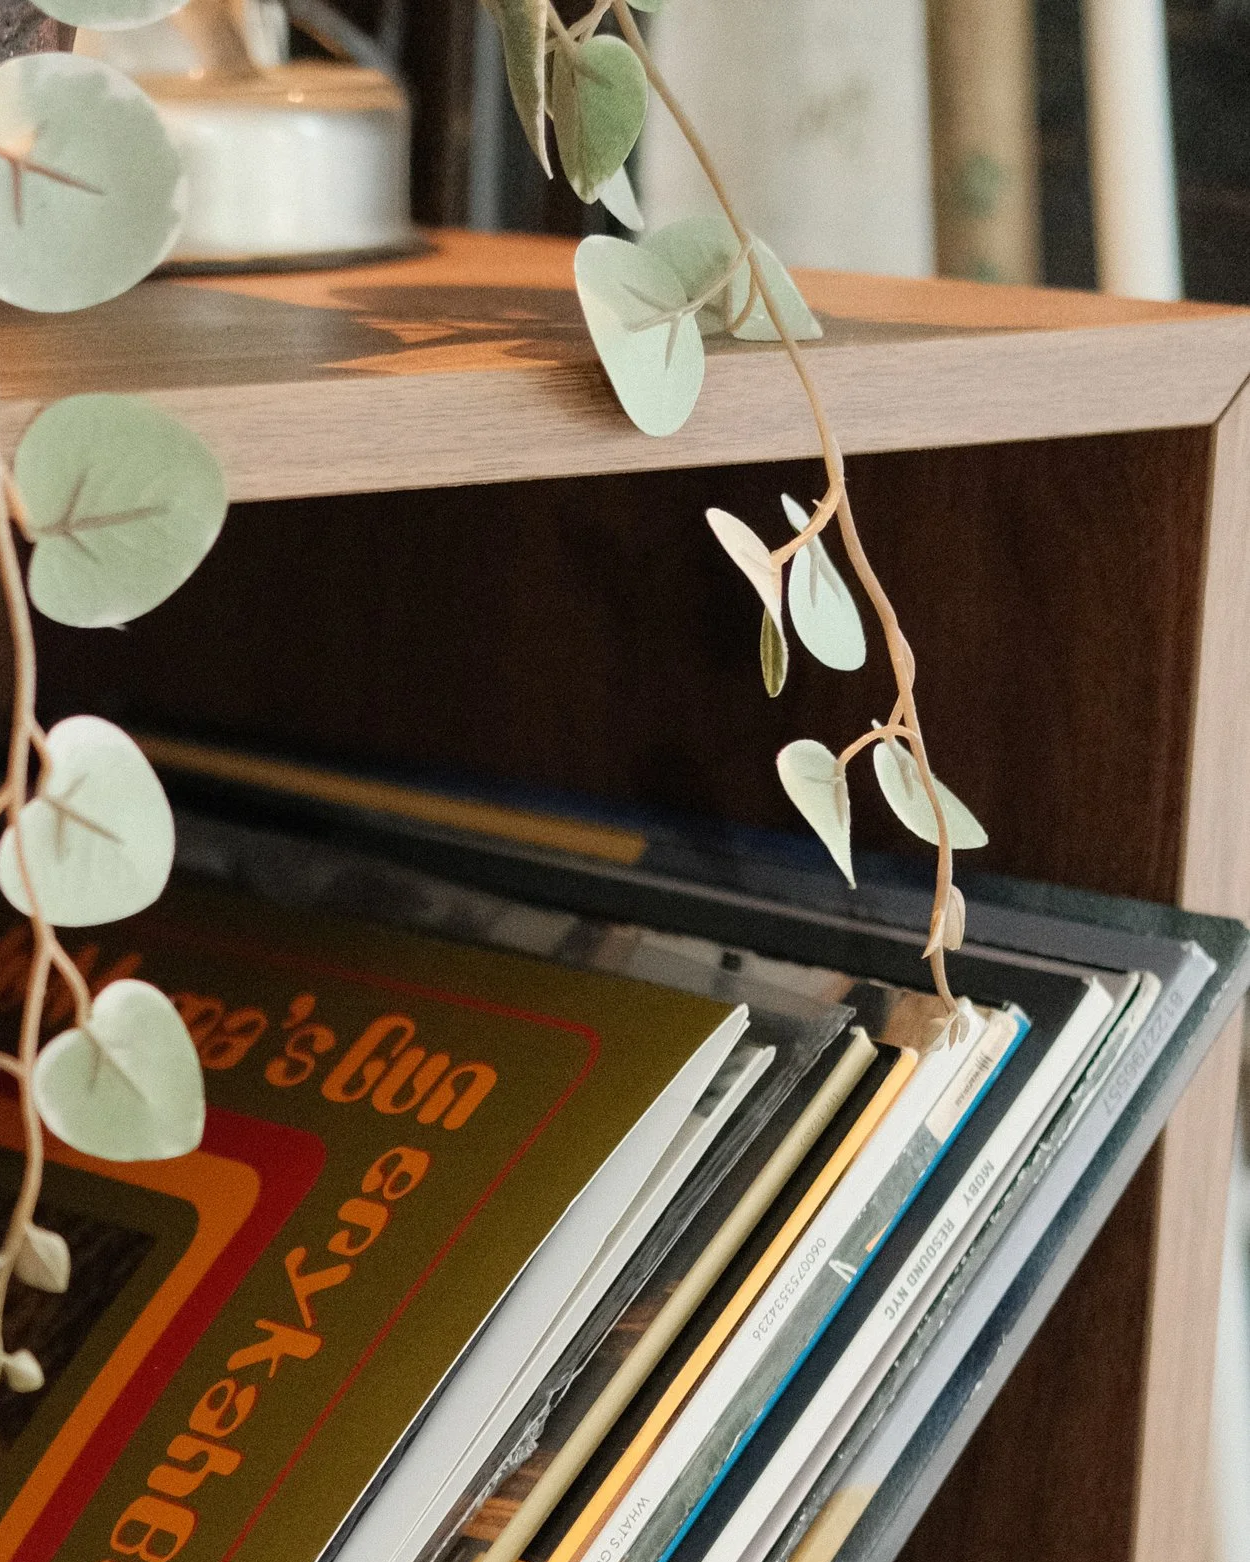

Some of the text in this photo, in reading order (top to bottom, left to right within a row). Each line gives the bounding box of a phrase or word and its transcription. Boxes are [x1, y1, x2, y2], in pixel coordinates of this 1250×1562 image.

[751, 1237, 826, 1340] 0600753534236
[882, 1162, 994, 1319] MOBY RESOUND NYC
[609, 1496, 648, 1547] WHAT'S
